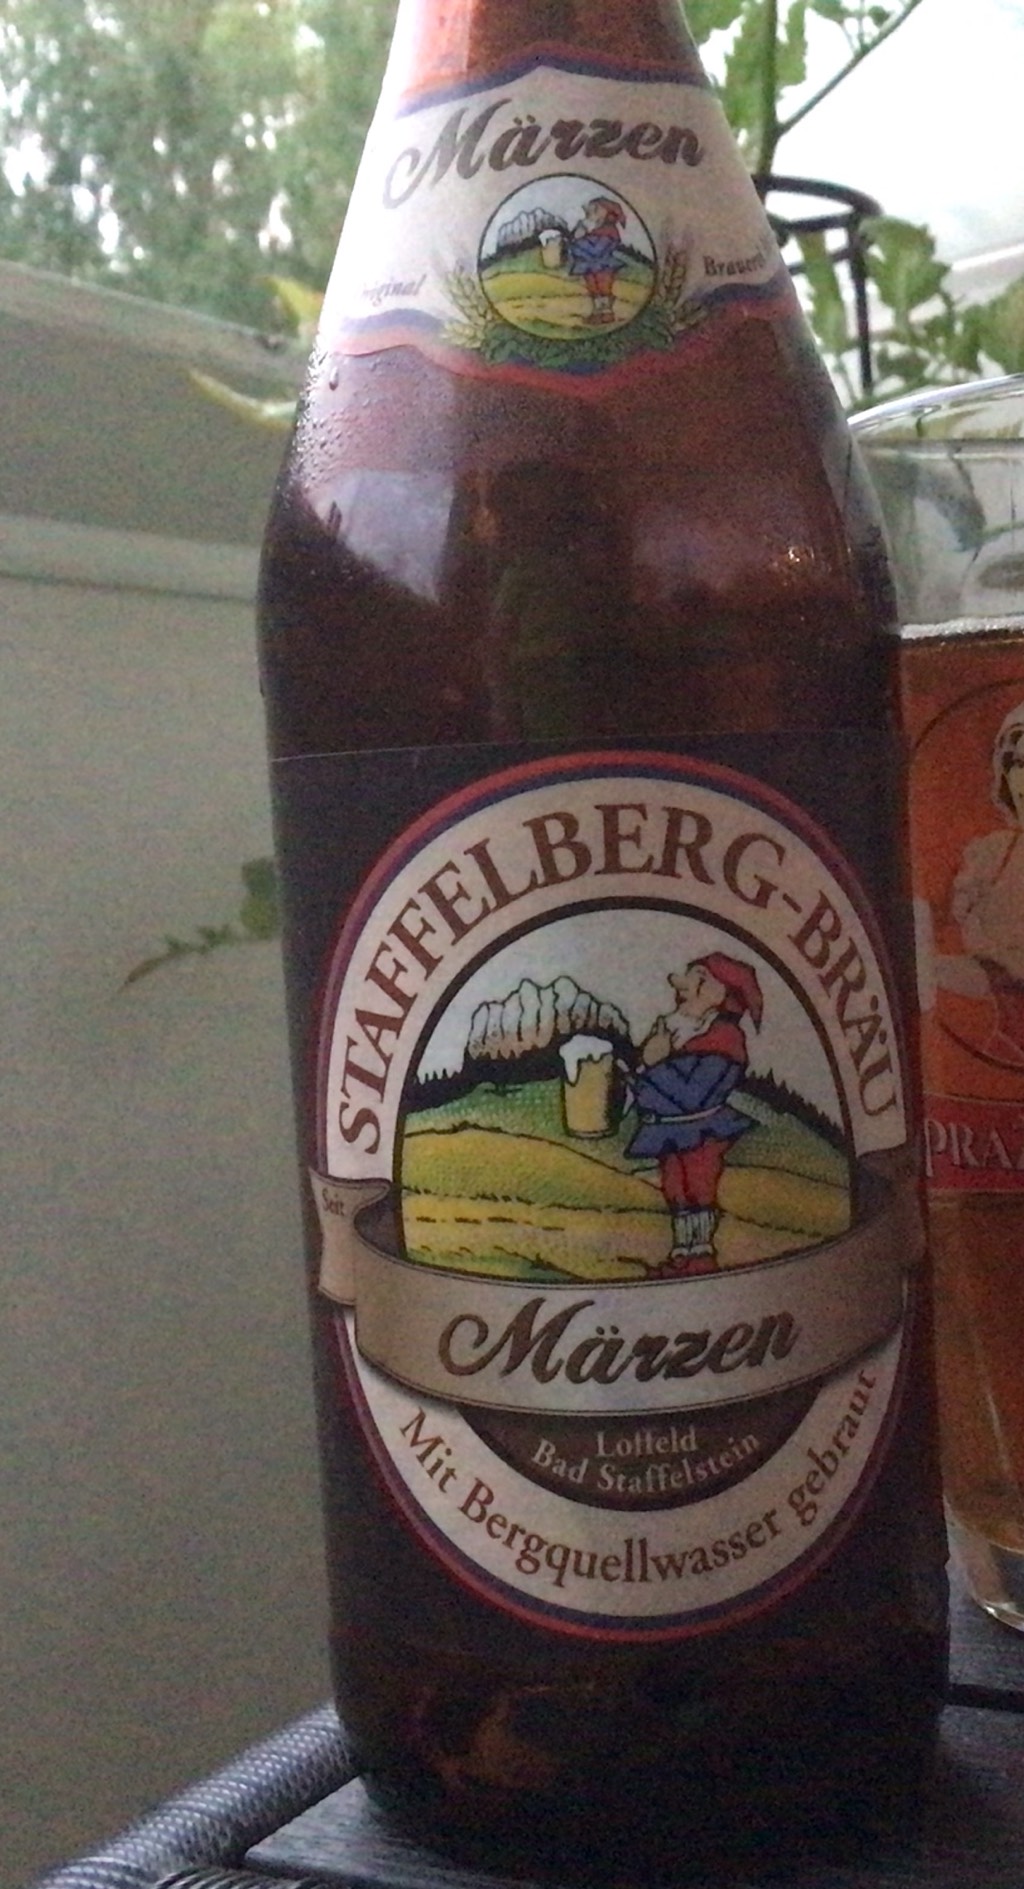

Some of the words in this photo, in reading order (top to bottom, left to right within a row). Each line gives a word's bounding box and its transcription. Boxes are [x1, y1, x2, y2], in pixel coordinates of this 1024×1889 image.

[383, 98, 704, 208] Märzen
[338, 803, 898, 1154] STAFFELBERG-BRÄU
[438, 1297, 801, 1385] Märzen
[400, 1407, 458, 1493] Mit
[457, 1480, 782, 1587] Bergquellwasser
[787, 1369, 878, 1527] gebraut
[532, 1438, 589, 1484] Bad
[598, 1432, 761, 1494] Staffelstein
